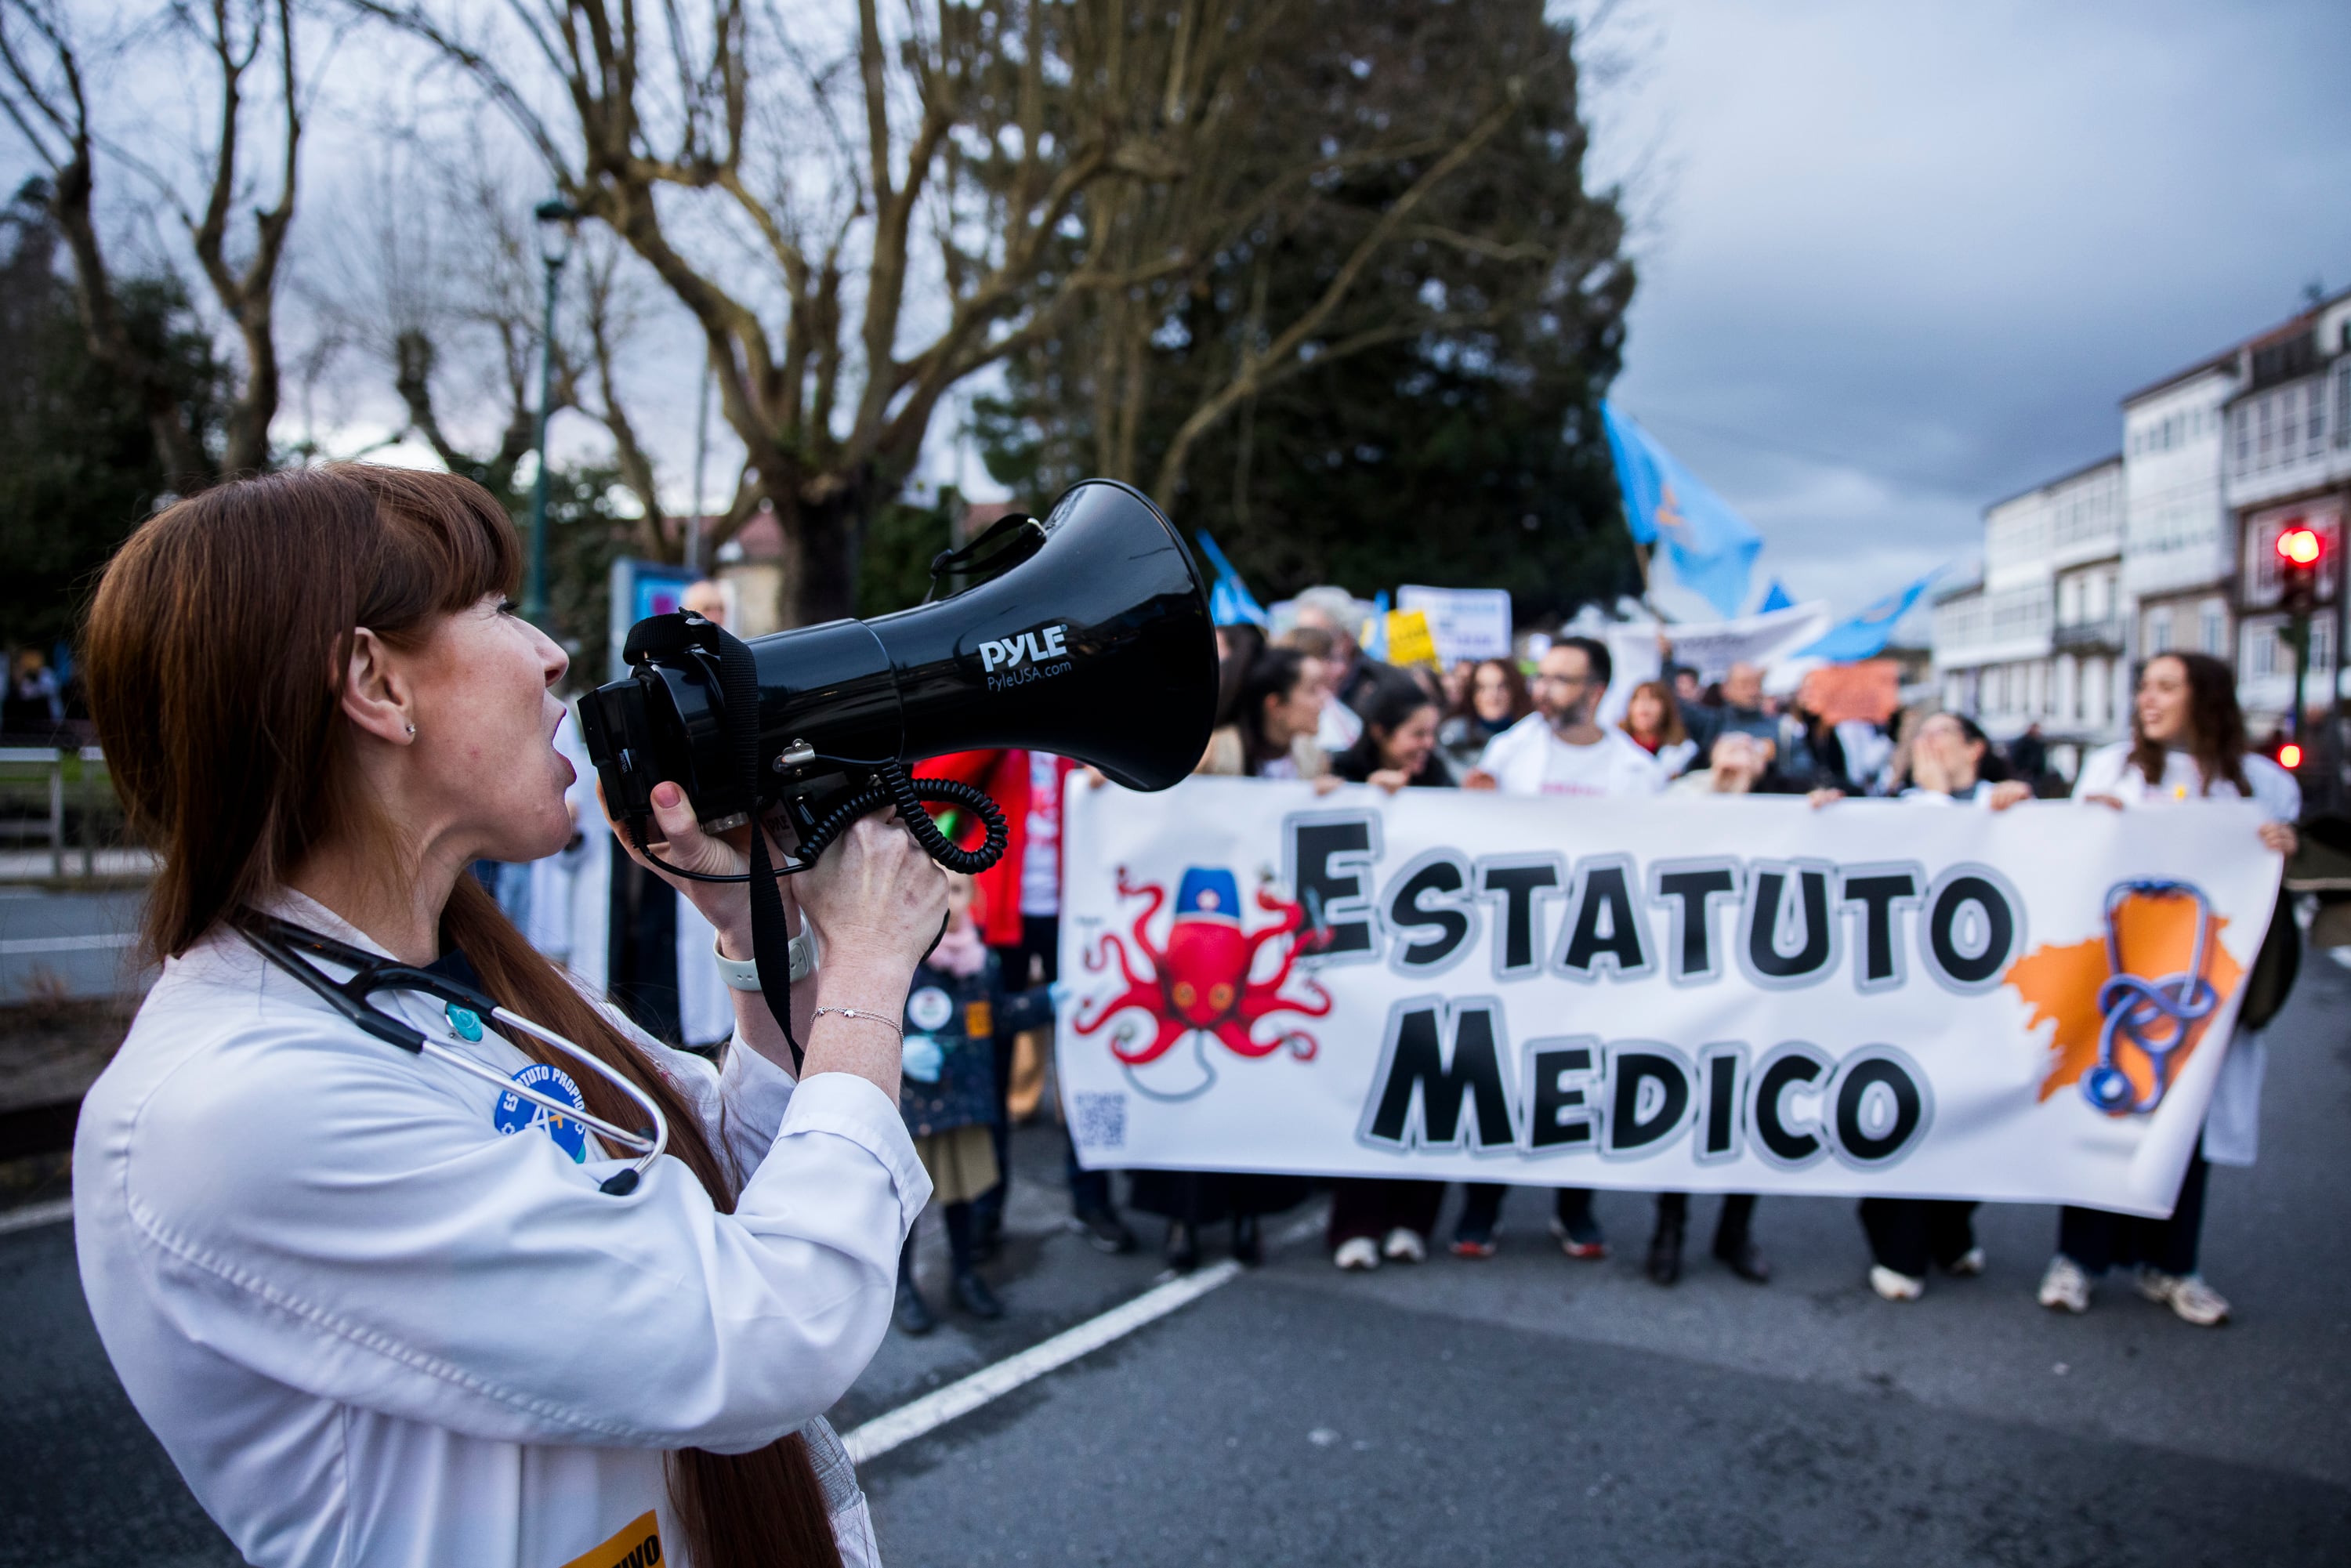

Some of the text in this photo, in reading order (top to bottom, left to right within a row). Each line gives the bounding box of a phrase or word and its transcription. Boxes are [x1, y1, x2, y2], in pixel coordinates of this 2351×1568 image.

[979, 625, 1067, 672] PYLE
[987, 661, 1072, 692] PyleUSA.com
[1293, 819, 2016, 984] ESTATUTO
[503, 1066, 585, 1112] ESTUTO PROPIO
[1368, 1004, 1923, 1162] MEDICO
